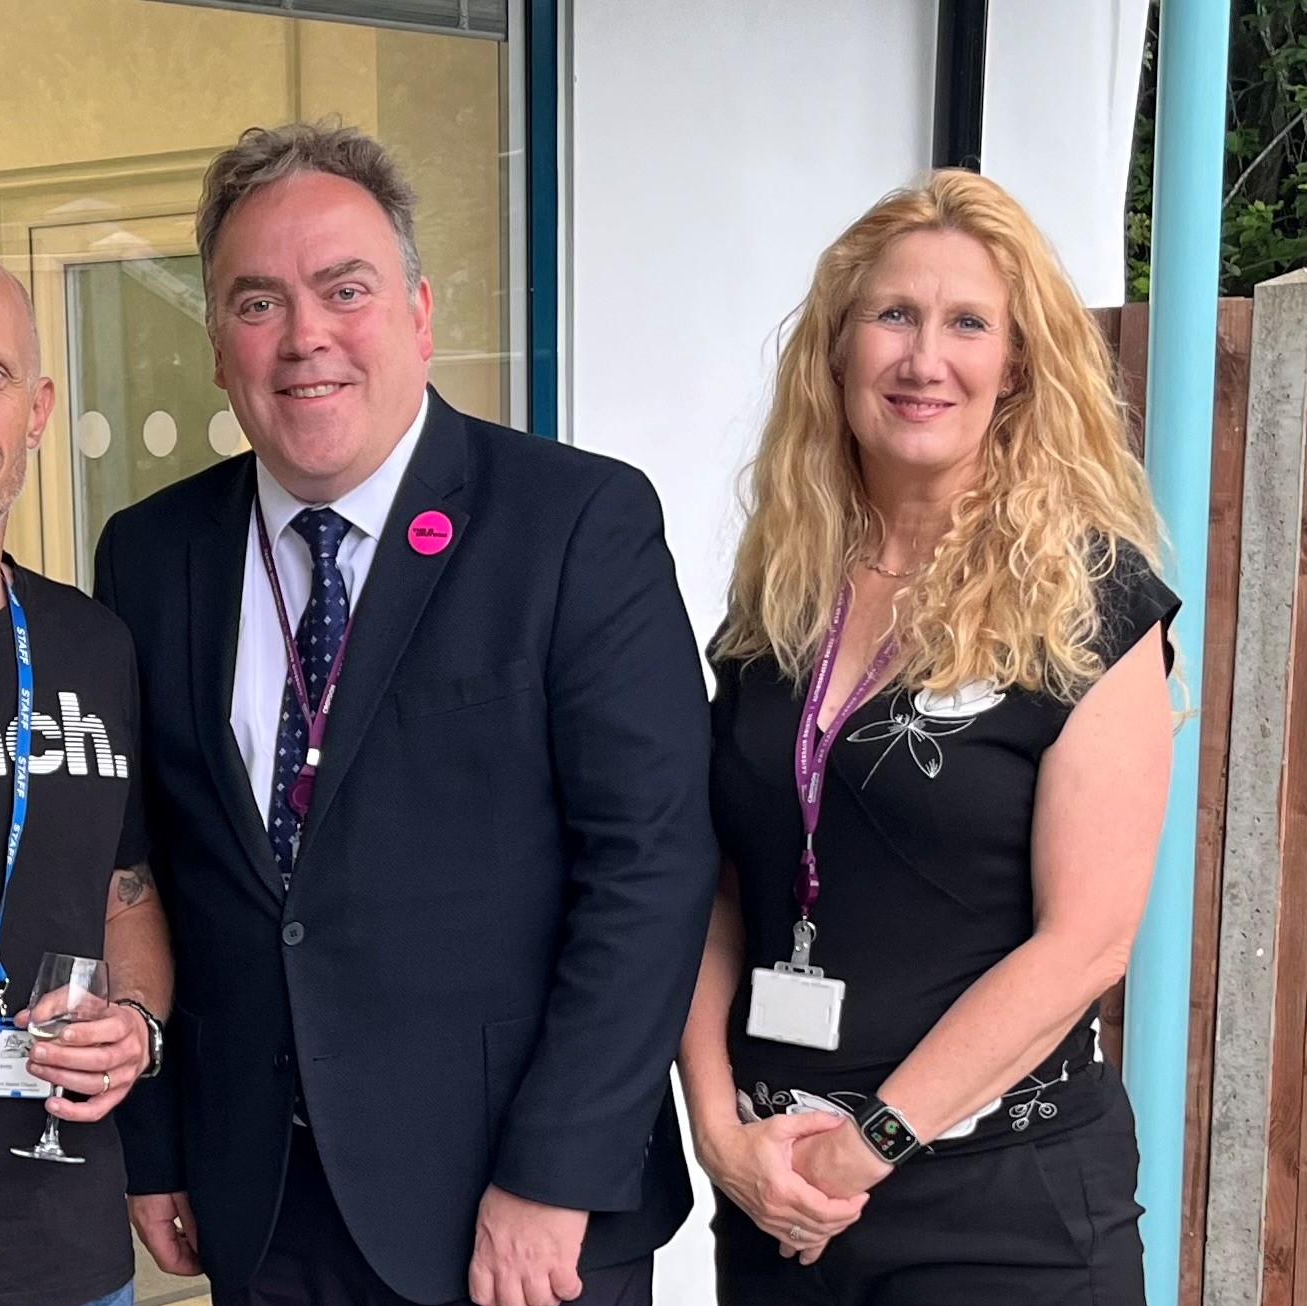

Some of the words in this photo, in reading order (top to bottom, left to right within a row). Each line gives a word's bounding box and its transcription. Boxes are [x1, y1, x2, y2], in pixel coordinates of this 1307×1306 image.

[16, 627, 30, 665] STAFF
[20, 688, 31, 731] STAFF
[16, 756, 27, 799] STAFF
[7, 823, 22, 865] STAFF
